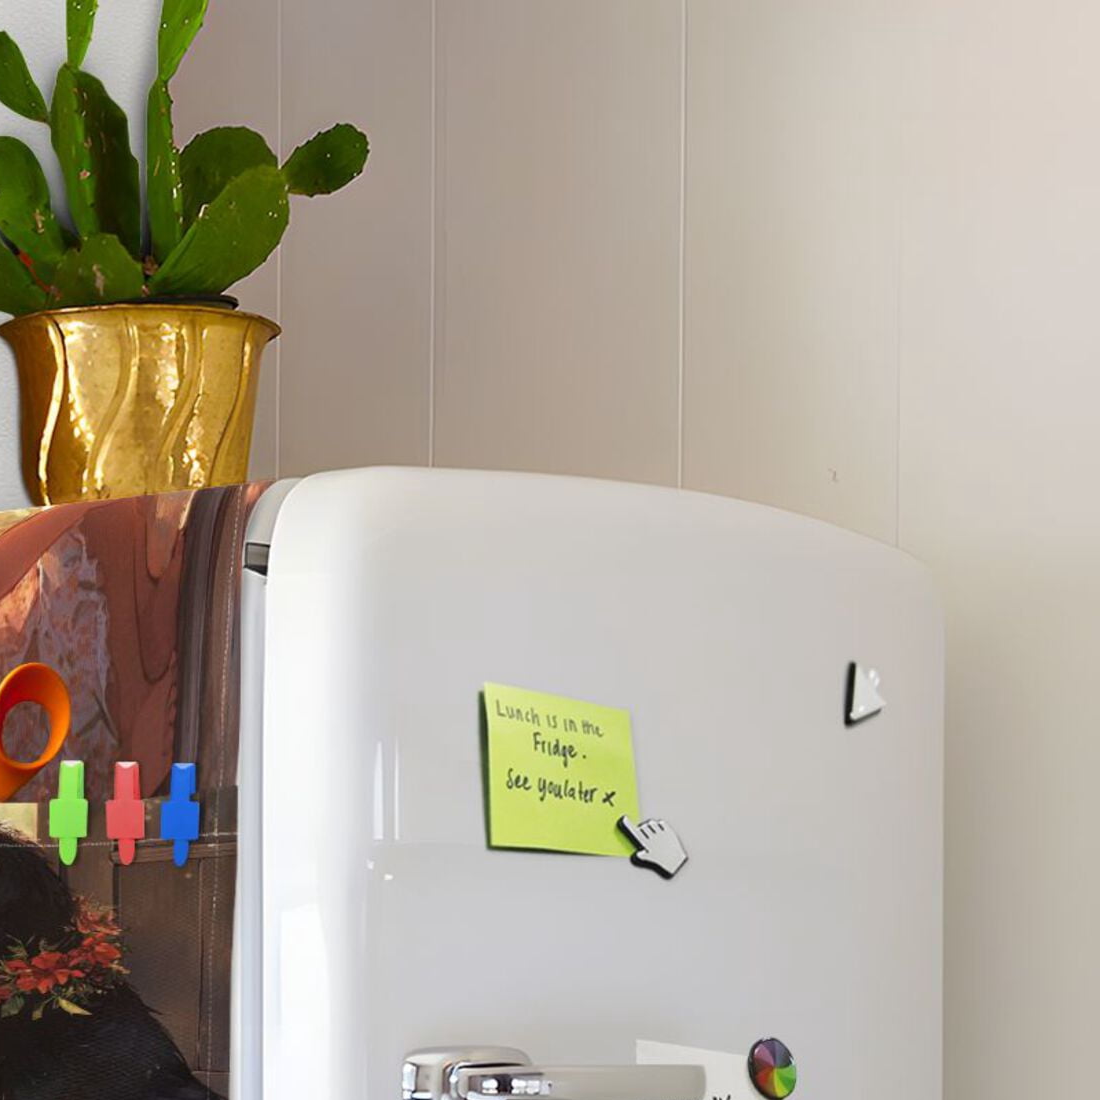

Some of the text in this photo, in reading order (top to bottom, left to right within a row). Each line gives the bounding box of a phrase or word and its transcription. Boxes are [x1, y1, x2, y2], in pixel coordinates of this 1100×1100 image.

[496, 699, 604, 738] Lunch is in the
[506, 768, 532, 790] See
